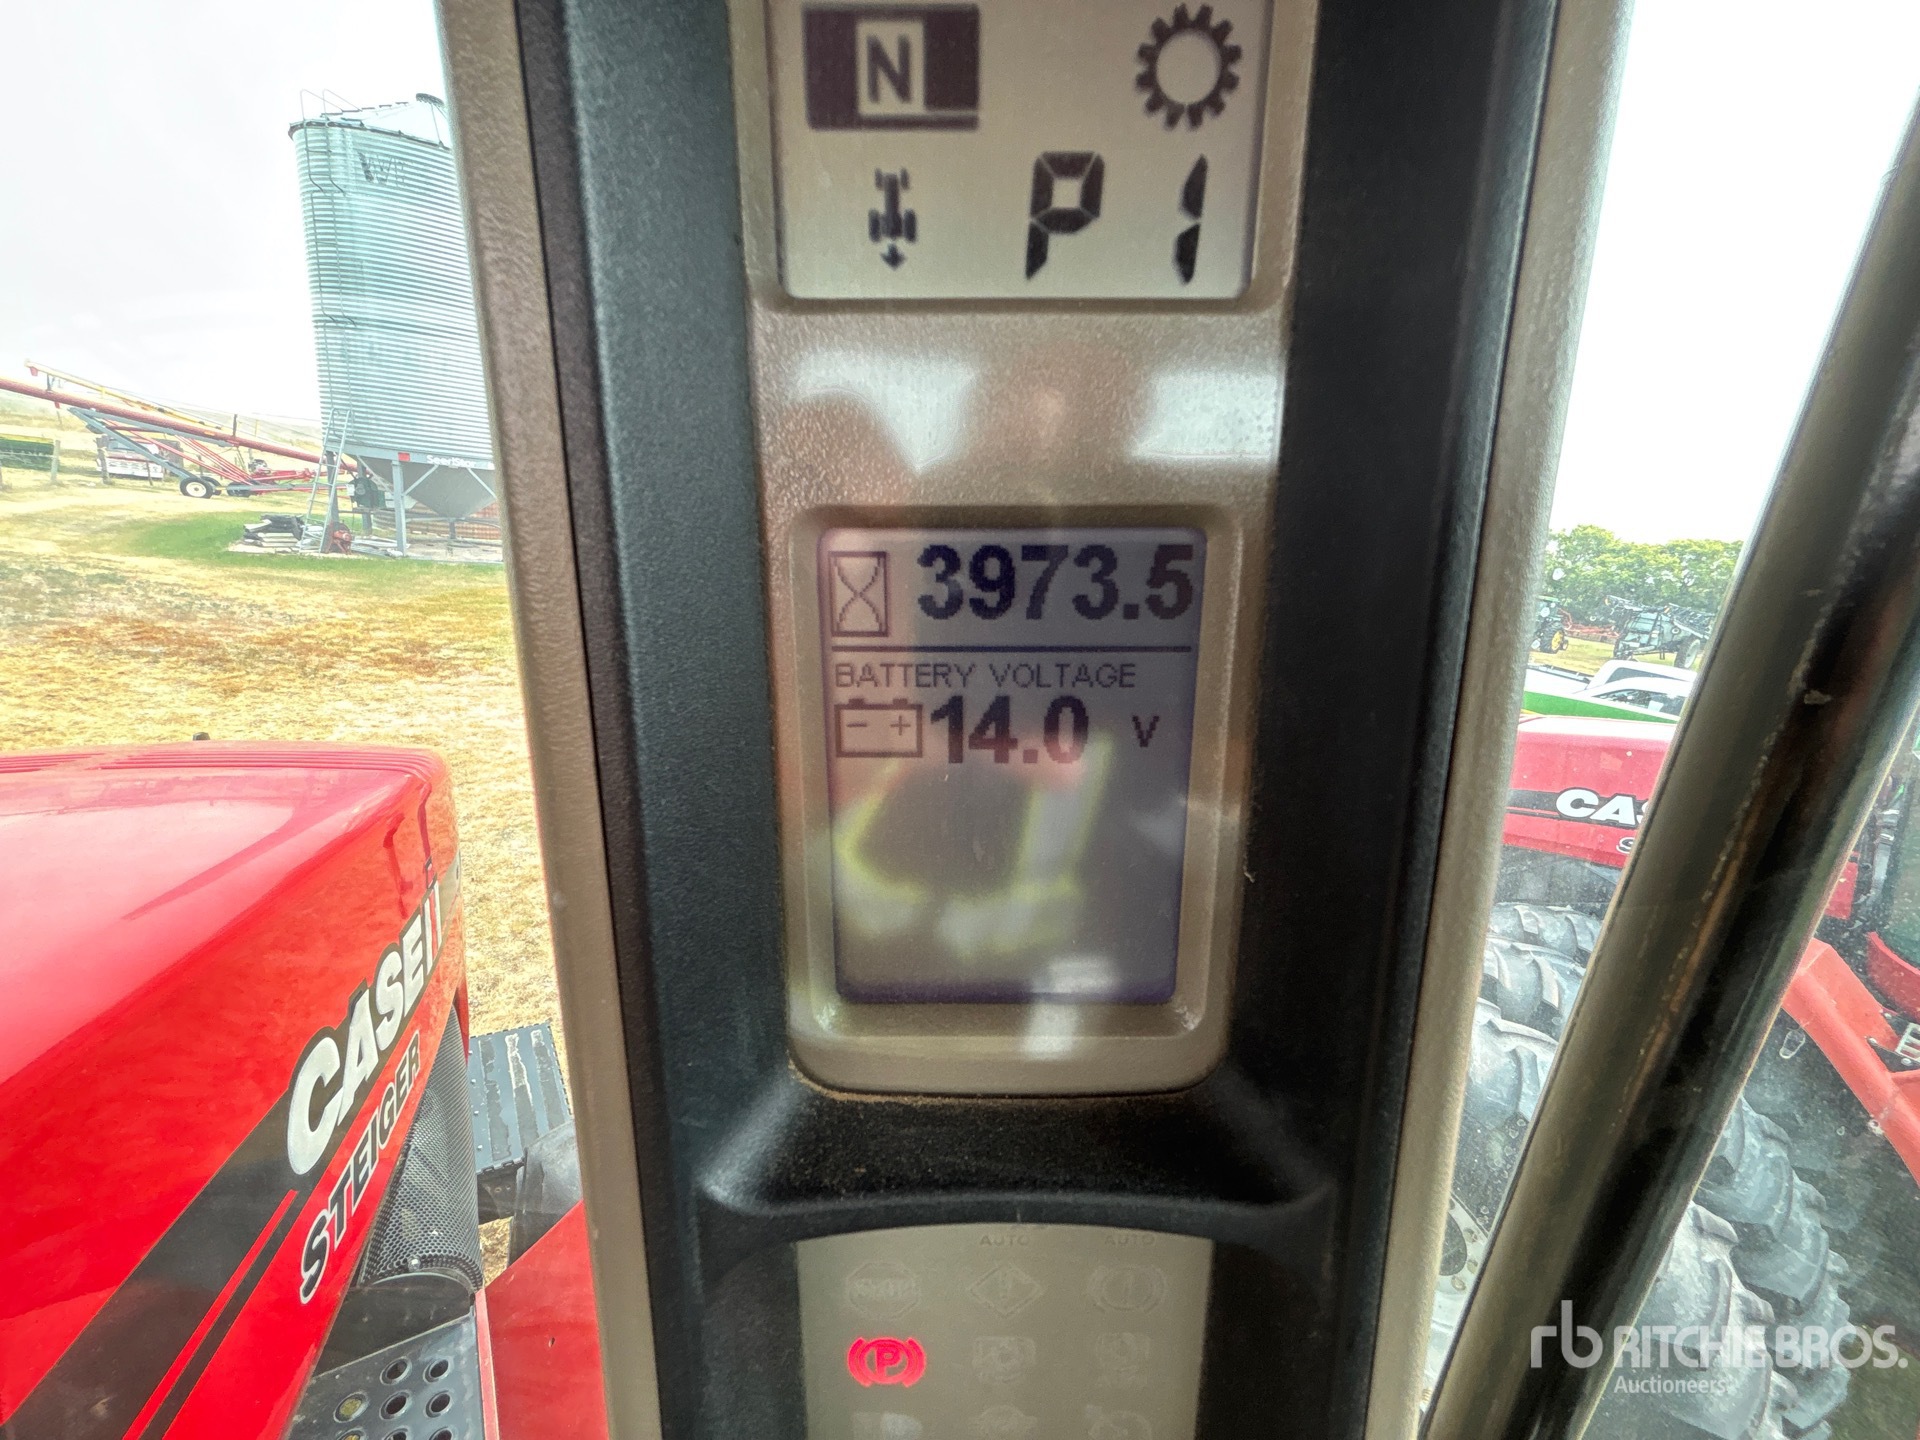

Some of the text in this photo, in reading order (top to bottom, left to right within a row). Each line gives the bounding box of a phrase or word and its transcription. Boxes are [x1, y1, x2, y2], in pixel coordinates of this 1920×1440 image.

[867, 35, 911, 102] N
[917, 544, 1194, 621] 3973.5
[835, 663, 1137, 688] BATTERY VOLTAGE
[930, 695, 1090, 764] 14.0
[1556, 788, 1649, 826] CA
[300, 1030, 421, 1305] STEIGER
[979, 1234, 1156, 1247] AUTO AUTO
